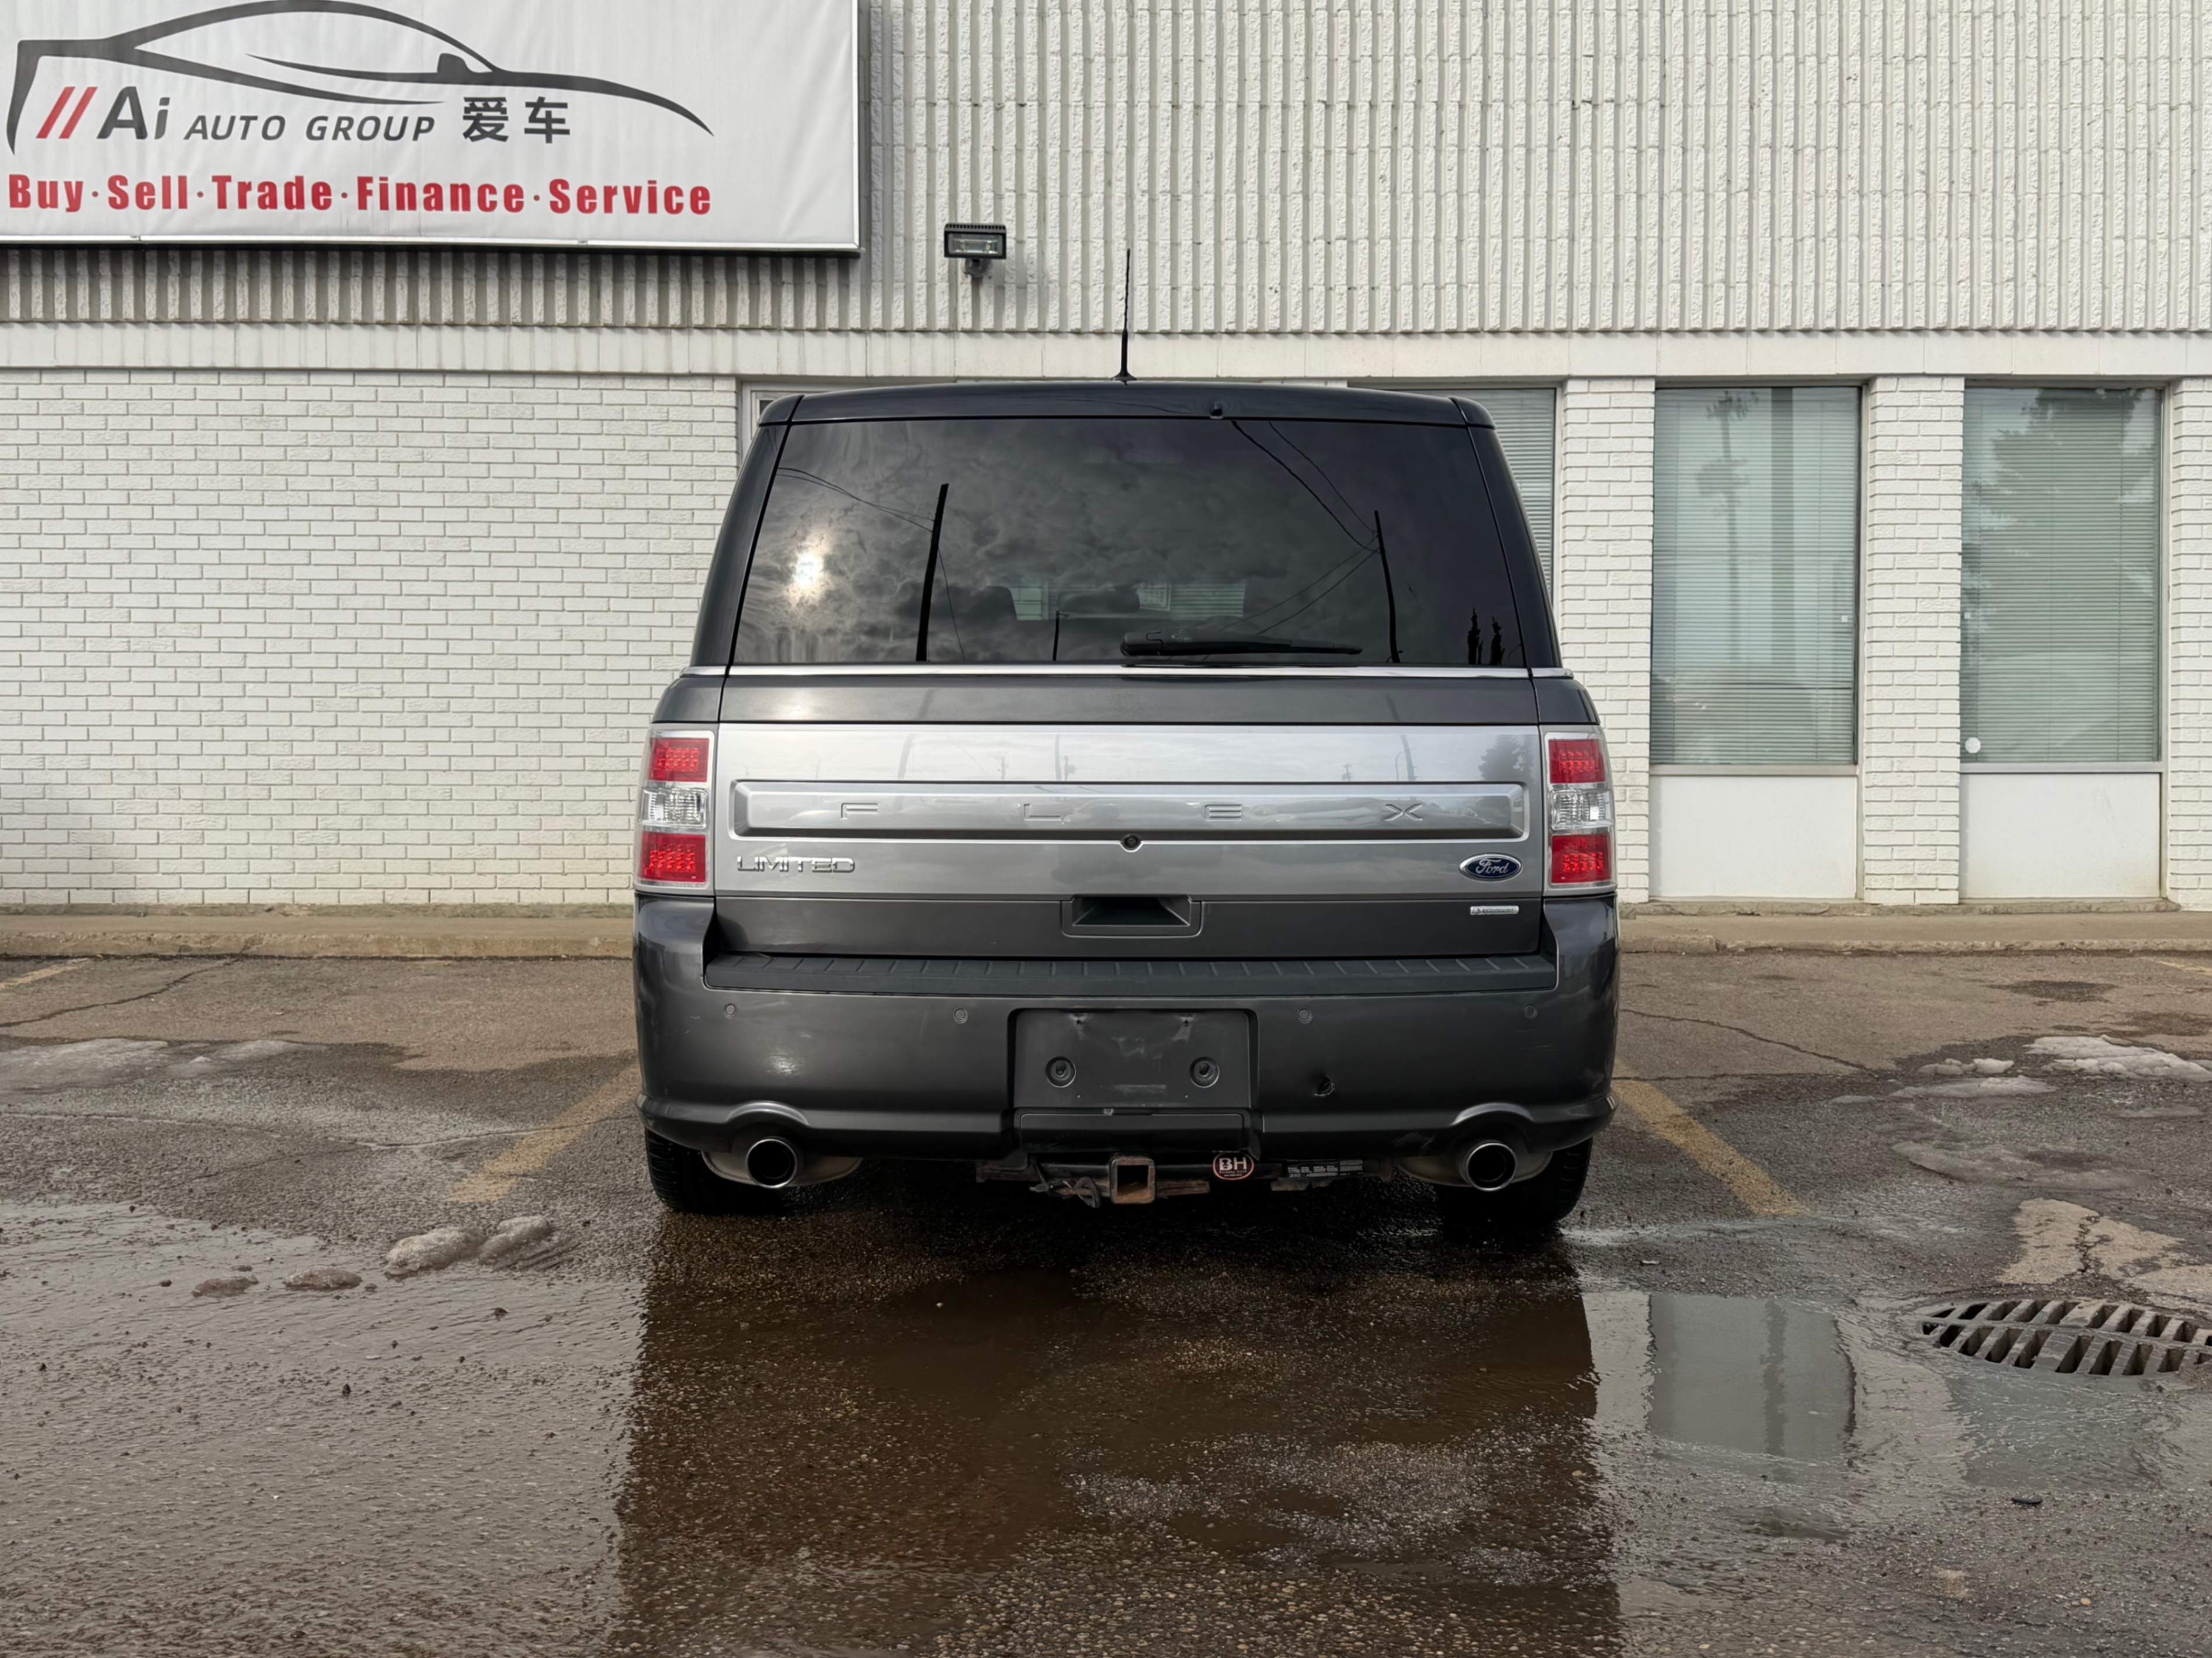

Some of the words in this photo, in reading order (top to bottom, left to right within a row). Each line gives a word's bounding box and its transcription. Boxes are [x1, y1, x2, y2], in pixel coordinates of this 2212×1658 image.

[184, 115, 286, 140] AUTO
[306, 116, 435, 141] GROUP
[462, 96, 570, 144] 爱车
[9, 174, 83, 213] Buy
[107, 175, 187, 210] Sell
[211, 175, 332, 211] Trade
[357, 176, 524, 213] Finance
[549, 178, 710, 215] Service
[840, 802, 1423, 821] FLEX
[737, 855, 856, 873] LIMITED
[1475, 858, 1510, 874] Ford
[1219, 1157, 1247, 1171] BH
